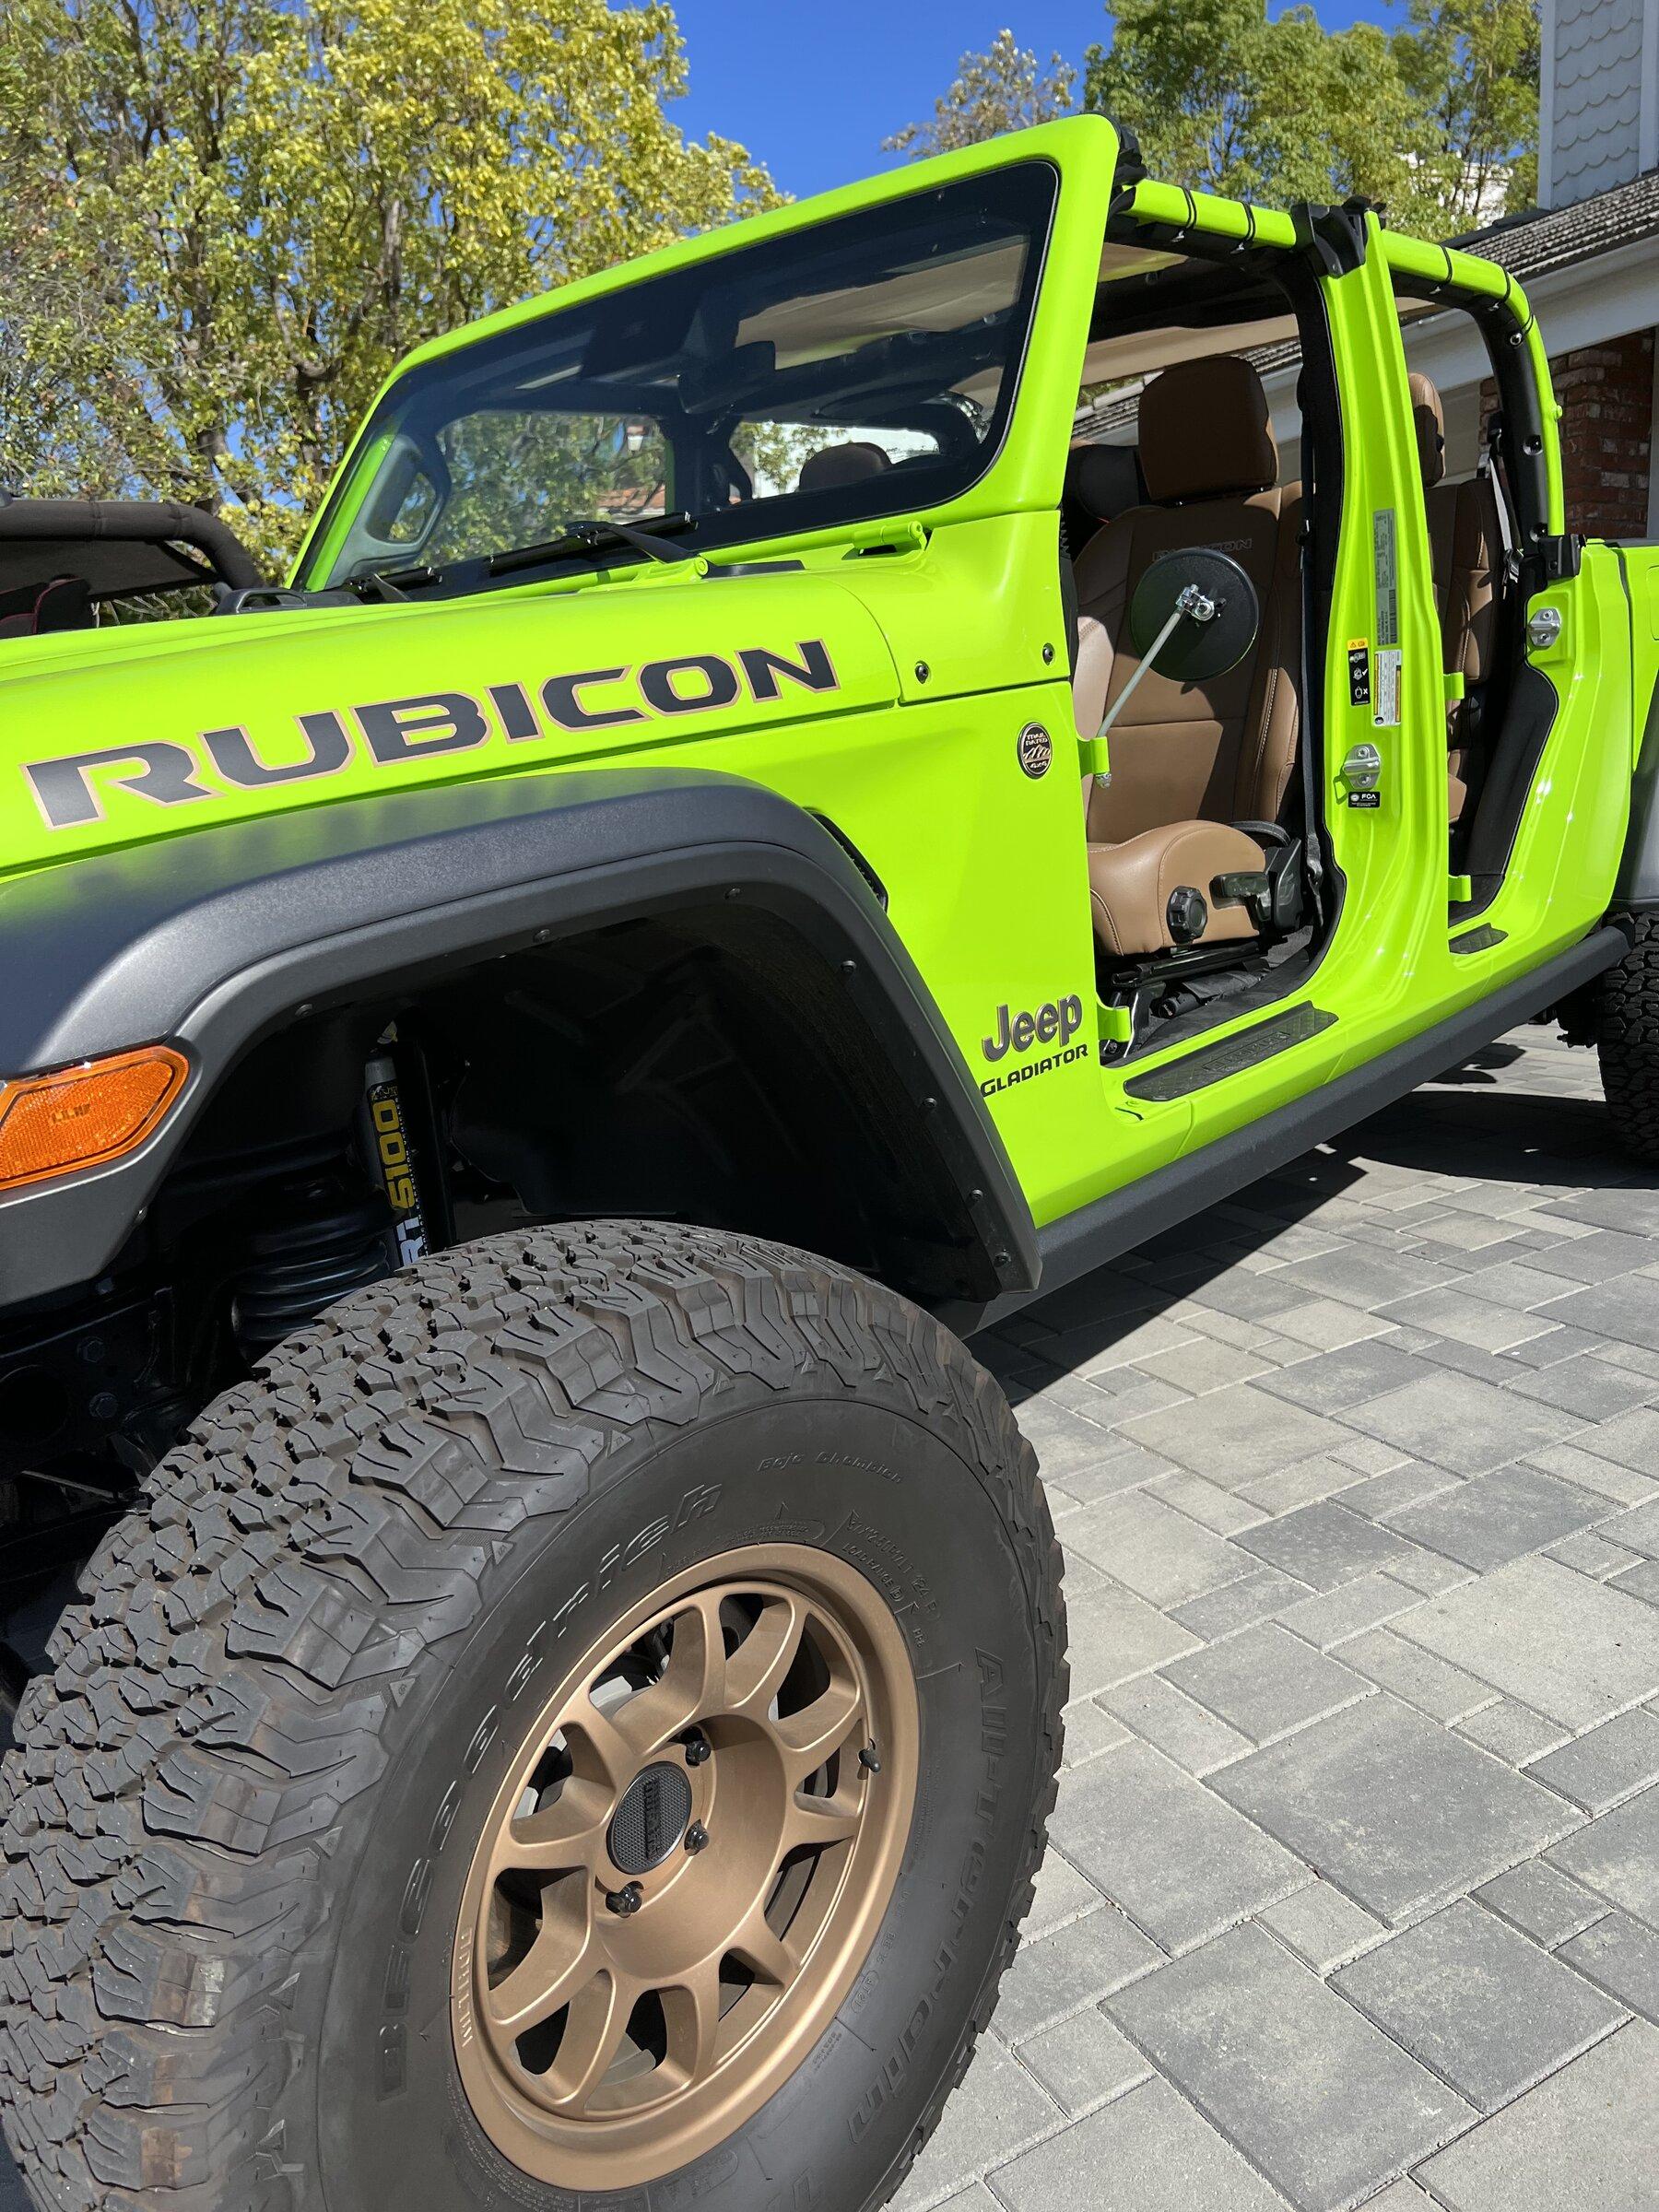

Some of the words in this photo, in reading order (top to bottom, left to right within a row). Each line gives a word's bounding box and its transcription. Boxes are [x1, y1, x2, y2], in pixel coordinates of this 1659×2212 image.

[20, 639, 841, 831] RUBICON
[1025, 737, 1048, 747] RATED
[980, 1043, 1088, 1098] GLADIATOR
[982, 994, 1083, 1063] Jeep
[372, 1099, 416, 1209] 5100
[848, 1646, 1007, 2144] All-Terrain
